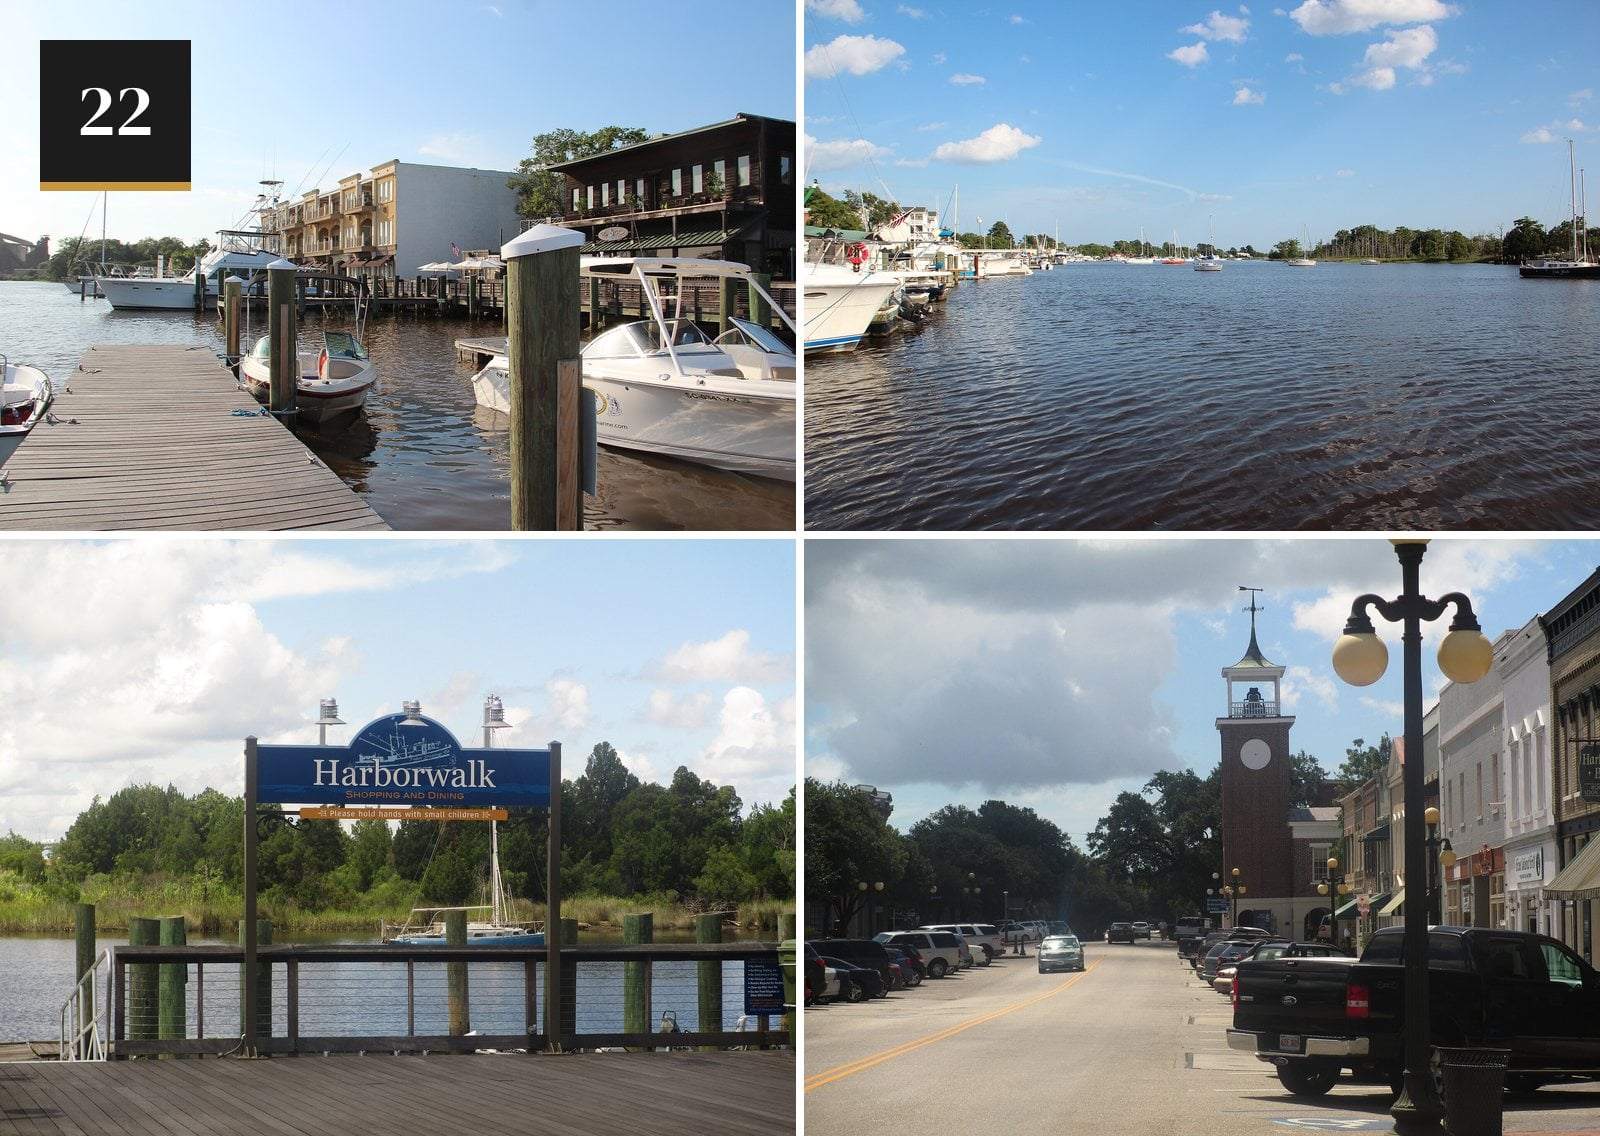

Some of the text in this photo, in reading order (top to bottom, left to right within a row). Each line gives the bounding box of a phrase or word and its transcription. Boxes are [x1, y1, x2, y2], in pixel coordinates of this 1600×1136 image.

[313, 758, 496, 788] Harborwalk
[329, 809, 480, 819] Please hold hands with small children
